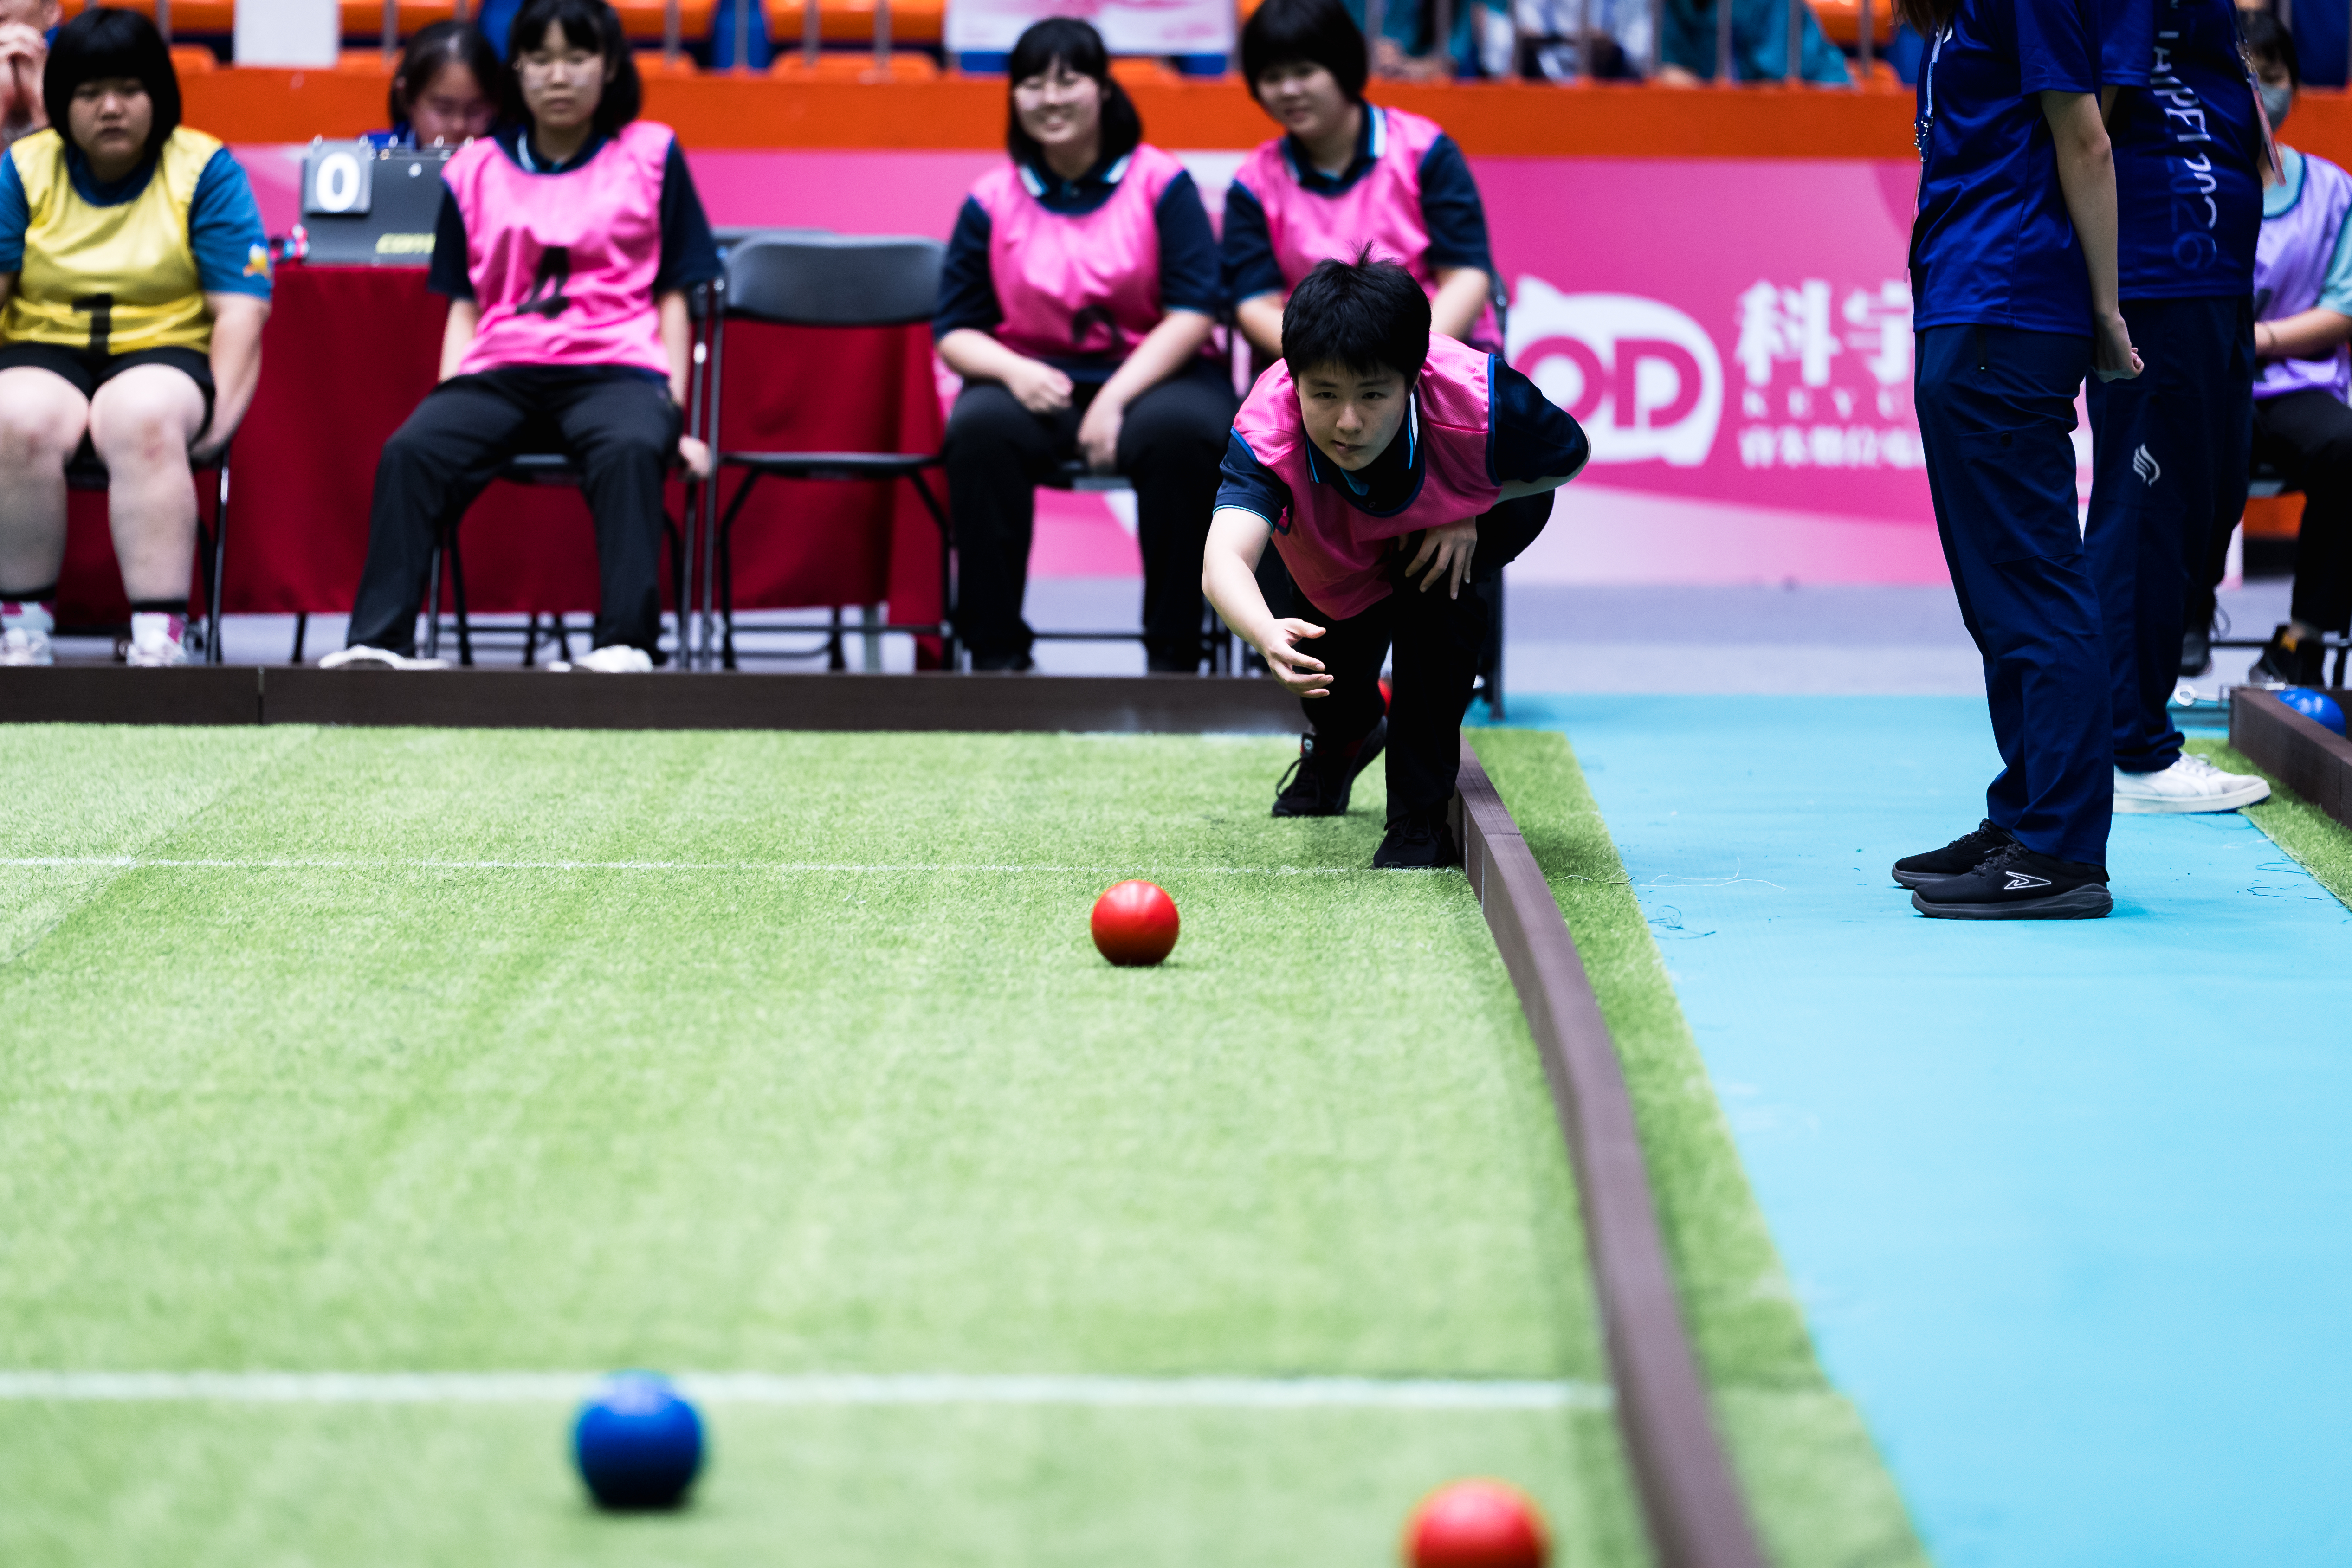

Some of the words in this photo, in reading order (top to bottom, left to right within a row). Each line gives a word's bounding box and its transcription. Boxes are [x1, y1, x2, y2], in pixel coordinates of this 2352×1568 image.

[317, 151, 360, 212] 0
[2166, 152, 2218, 270] 2026
[71, 293, 112, 358] 1
